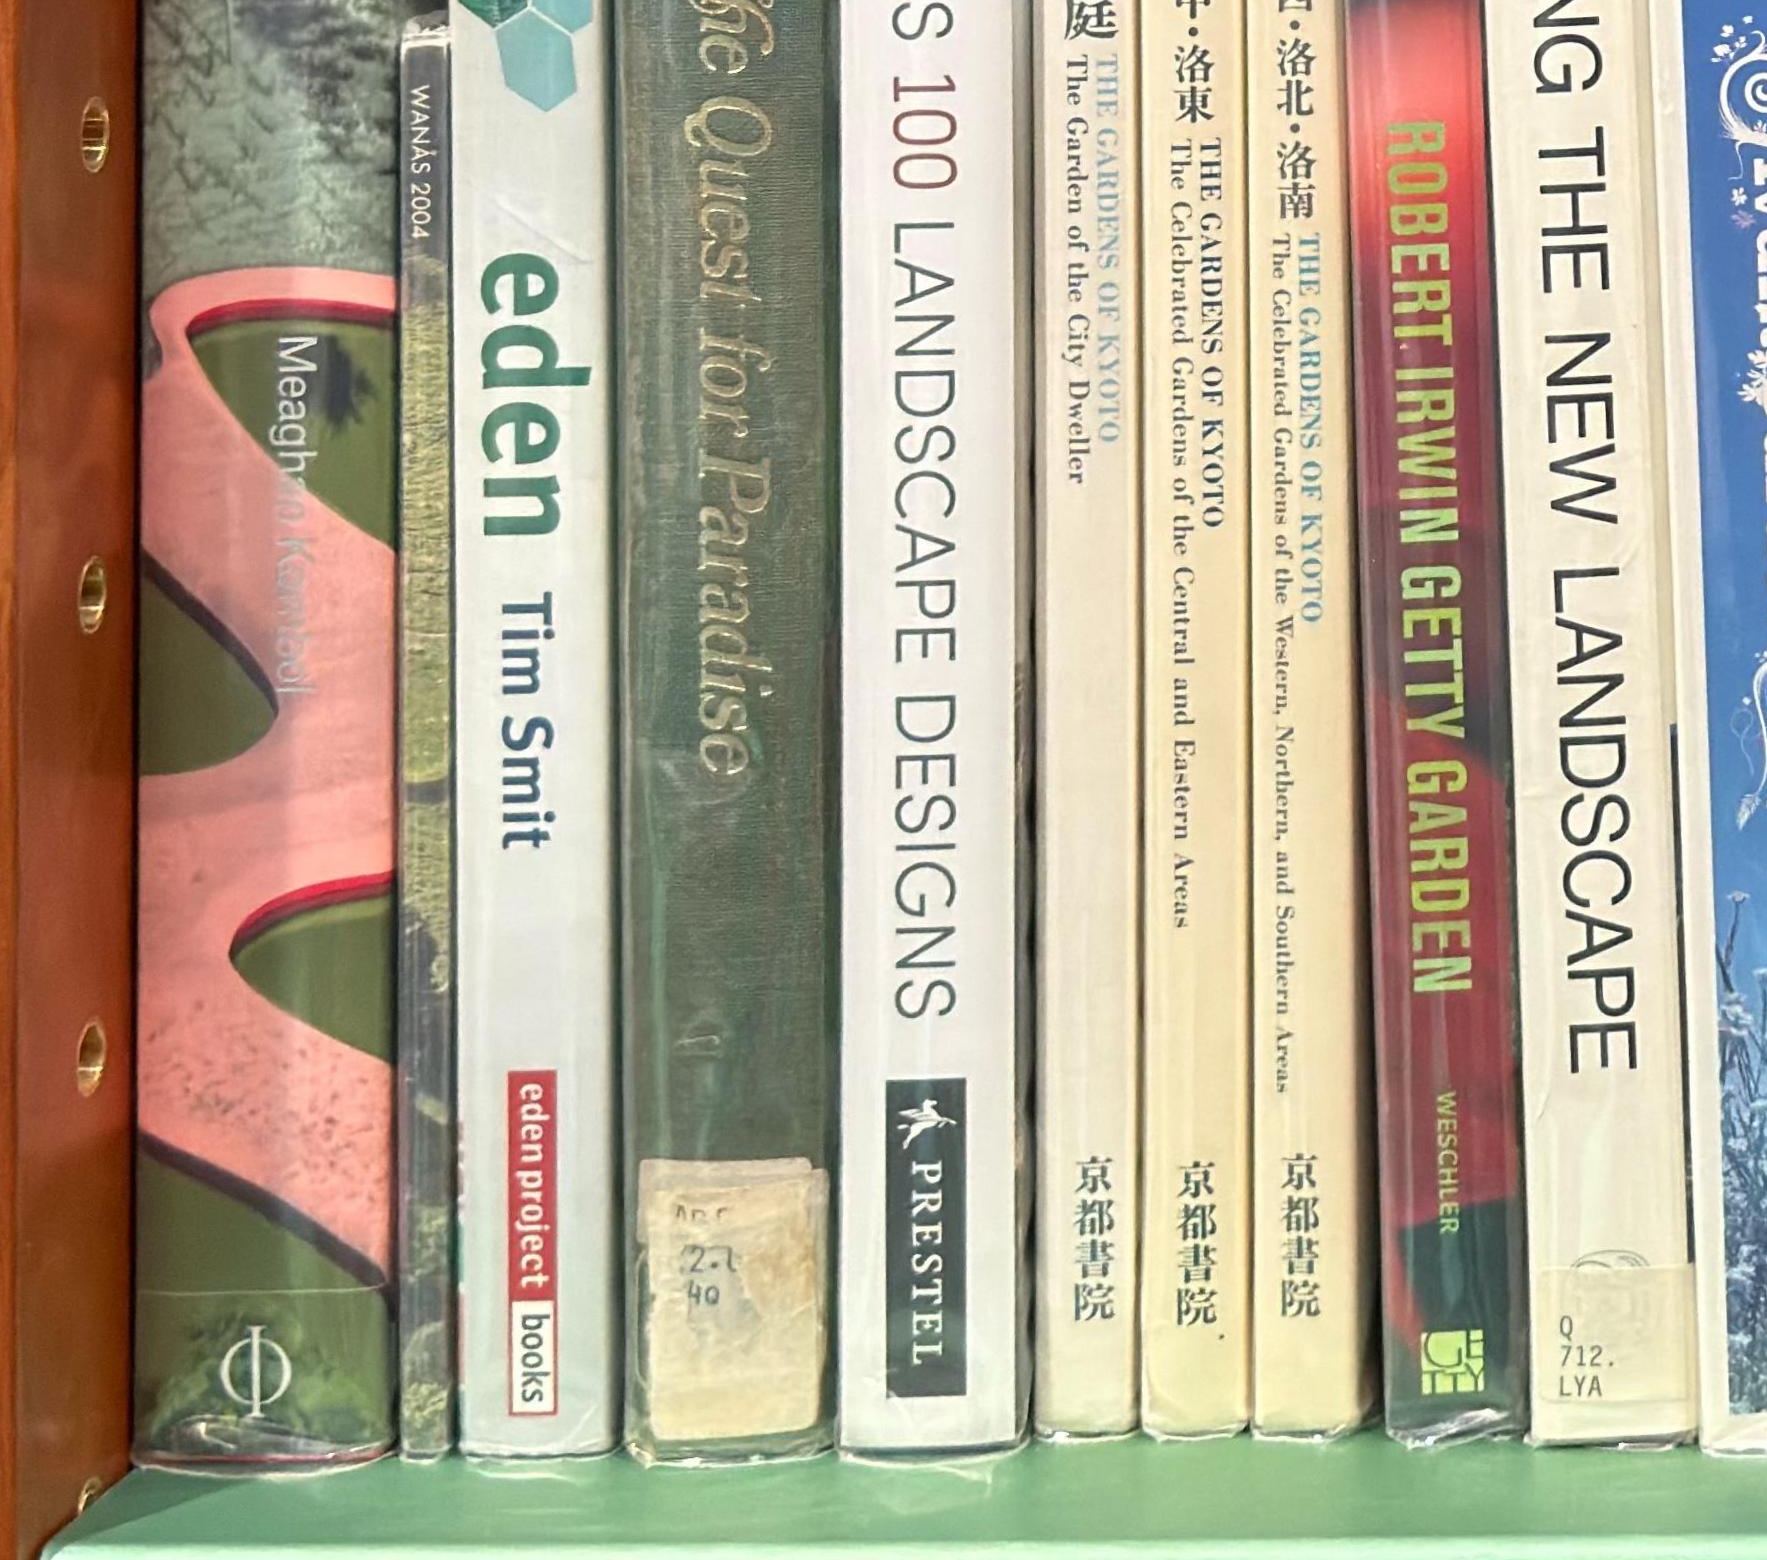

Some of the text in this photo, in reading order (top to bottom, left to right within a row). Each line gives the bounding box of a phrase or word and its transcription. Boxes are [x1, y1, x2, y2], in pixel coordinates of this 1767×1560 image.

[410, 182, 432, 239] 2004
[683, 94, 776, 312] Quest
[892, 74, 958, 189] 100
[1538, 125, 1611, 294] THE
[698, 324, 772, 439] for
[893, 221, 957, 664] LANDSCAPE
[1544, 332, 1618, 525] NEW
[480, 251, 593, 850] eden Tim Smit
[696, 455, 775, 777] Paradise
[1170, 137, 1196, 931] The Celebrated Gardens of the Central and Eastern Areas
[1385, 120, 1473, 993] ROBERT IRWIN GETTY GARDEN
[894, 695, 957, 1020] DESIGNS
[1553, 566, 1638, 1074] LANDSCAPE
[515, 1082, 549, 1288] eden project
[1072, 1155, 1116, 1322] 京都書院
[1176, 1160, 1219, 1327] 京都書院
[1279, 1152, 1322, 1319] 京都書院
[1436, 1090, 1460, 1235] WESCHLER
[910, 1159, 944, 1366] PRESTEL
[1558, 1314, 1574, 1340] Q
[519, 1312, 550, 1404] books
[1558, 1375, 1603, 1398] LYA
[1559, 1344, 1616, 1368] 712.
